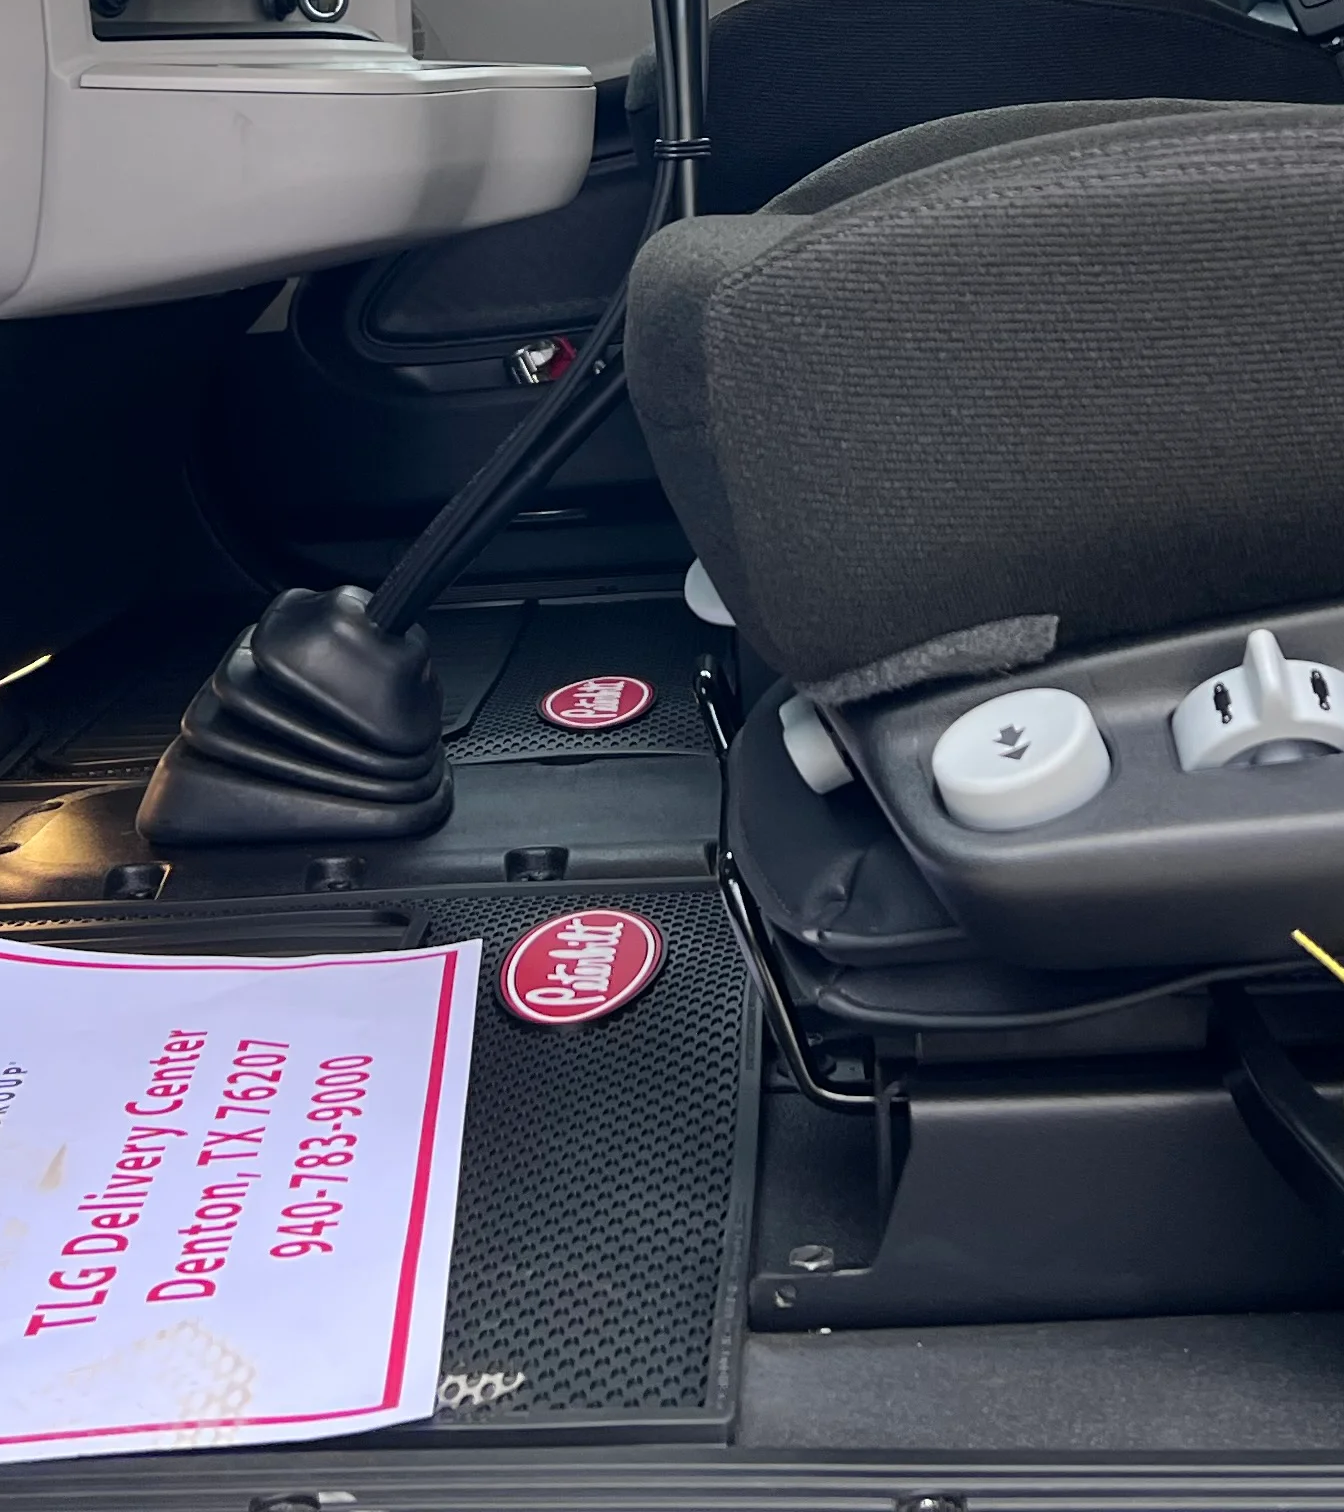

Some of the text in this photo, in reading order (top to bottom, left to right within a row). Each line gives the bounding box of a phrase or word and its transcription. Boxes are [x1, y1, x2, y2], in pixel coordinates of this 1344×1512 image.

[559, 678, 626, 720] Peterbilt
[524, 916, 625, 1007] Peterbilt
[22, 1028, 208, 1337] TLG Delivery Center
[145, 1038, 291, 1305] Denton, TX 76207
[268, 1054, 374, 1259] 940-783-9000
